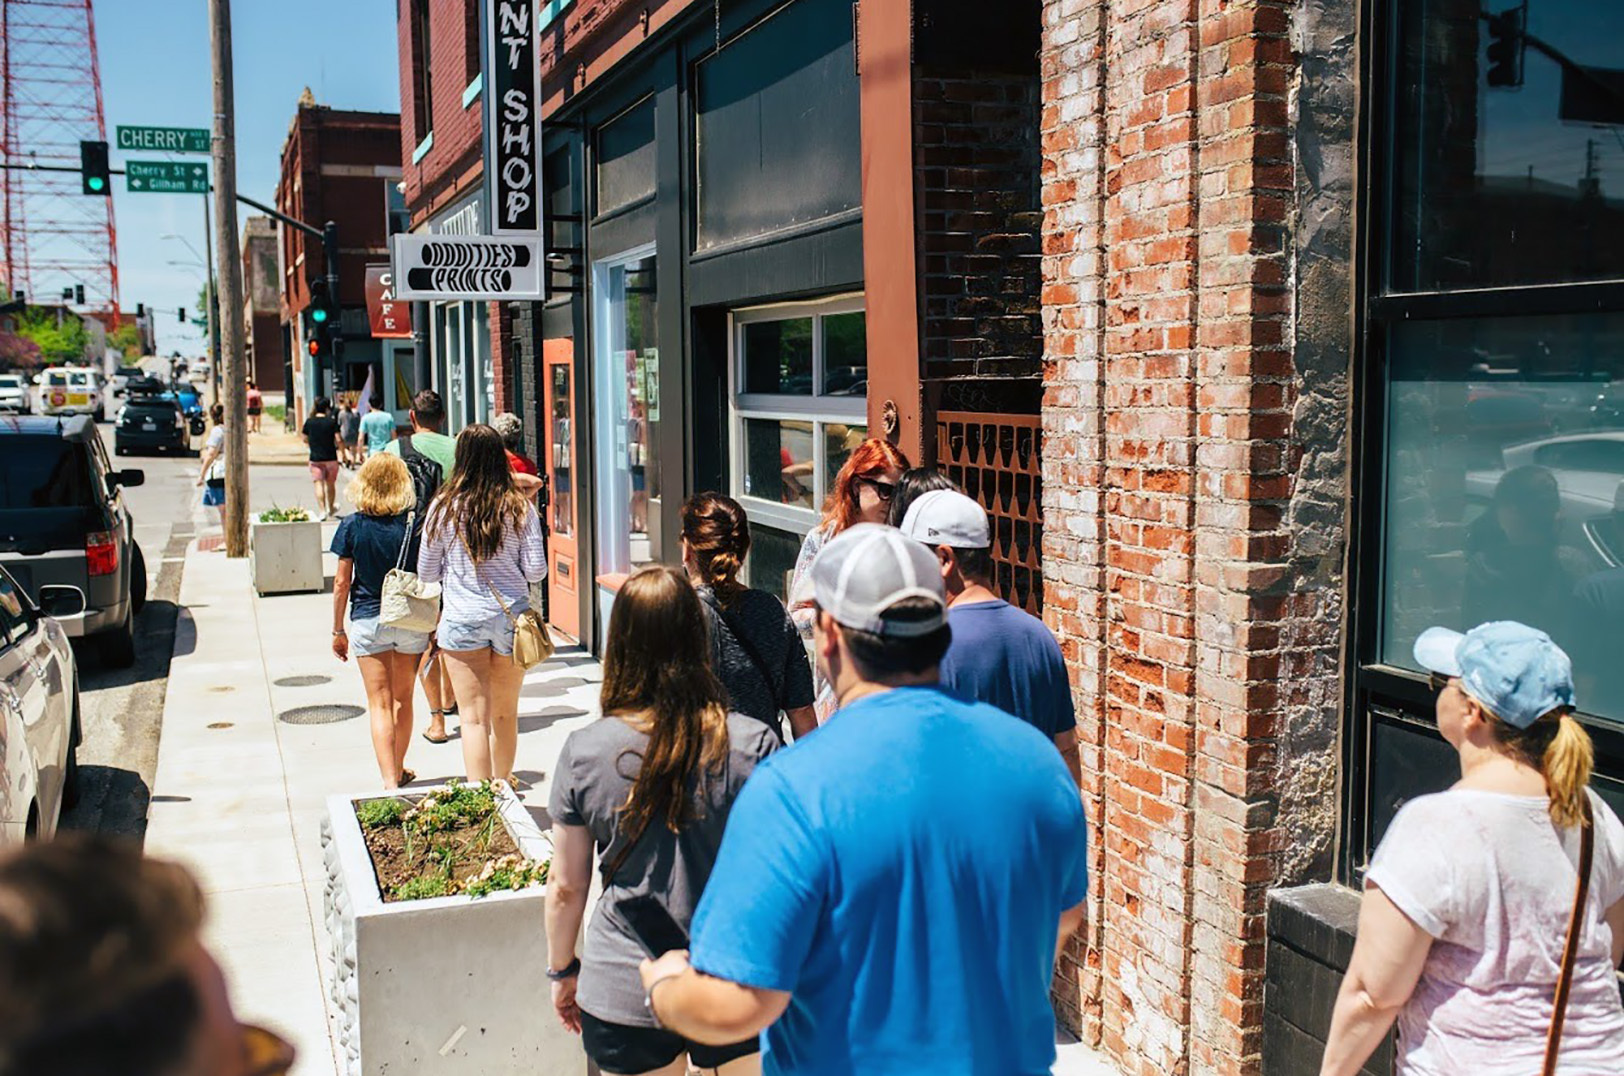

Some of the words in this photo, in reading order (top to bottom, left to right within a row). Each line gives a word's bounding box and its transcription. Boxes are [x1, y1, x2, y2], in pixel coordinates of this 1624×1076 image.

[499, 0, 530, 70] NT
[120, 129, 187, 148] CHERRY
[195, 139, 206, 149] ST
[501, 88, 533, 224] SHOP
[129, 164, 166, 177] Cherry
[173, 165, 185, 177] St
[149, 178, 186, 190] Gillham
[192, 180, 206, 191] Rd
[431, 242, 513, 268] ODDITIES
[435, 267, 502, 292] PRINTS
[379, 273, 396, 330] CAFE
